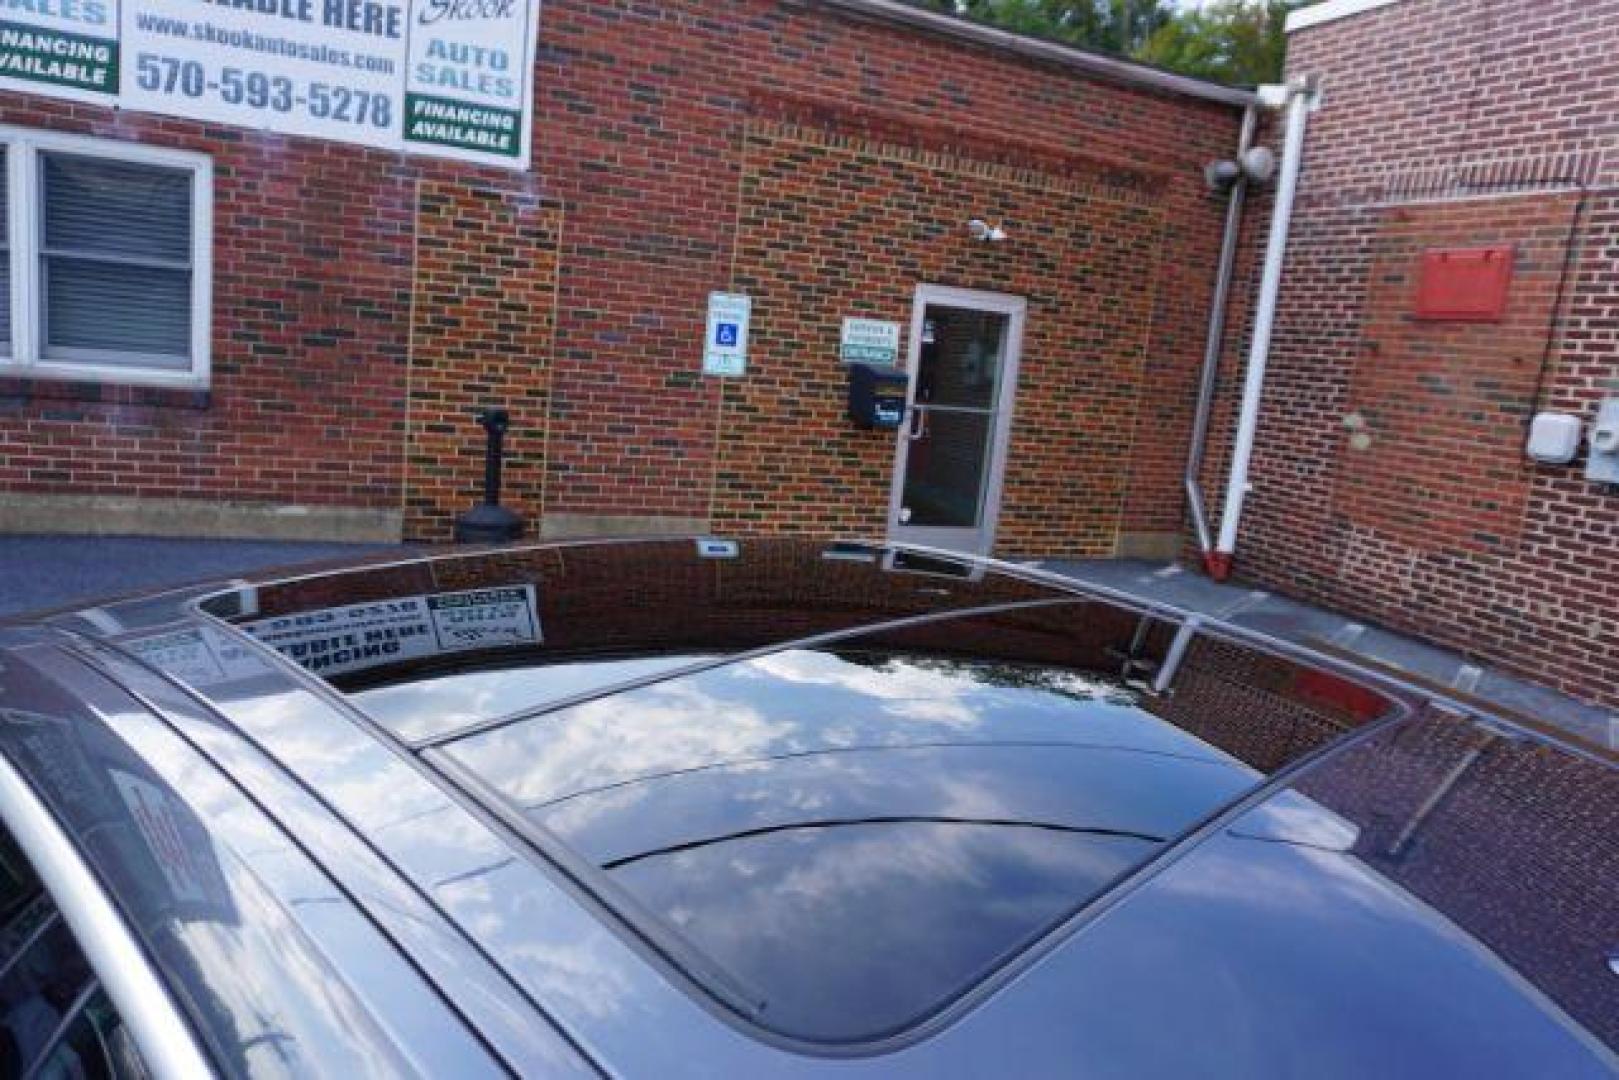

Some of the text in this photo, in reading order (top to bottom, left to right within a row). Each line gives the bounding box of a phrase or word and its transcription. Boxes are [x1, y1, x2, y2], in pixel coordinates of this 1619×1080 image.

[0, 0, 107, 25] ALES
[323, 0, 401, 39] HERE
[136, 13, 395, 74] www.skookautosales.com
[425, 38, 509, 71] AUTO
[136, 52, 392, 129] 570-593-5278
[415, 62, 514, 97] SALES
[414, 100, 514, 130] FINANCING
[412, 121, 510, 149] AVAILABLE
